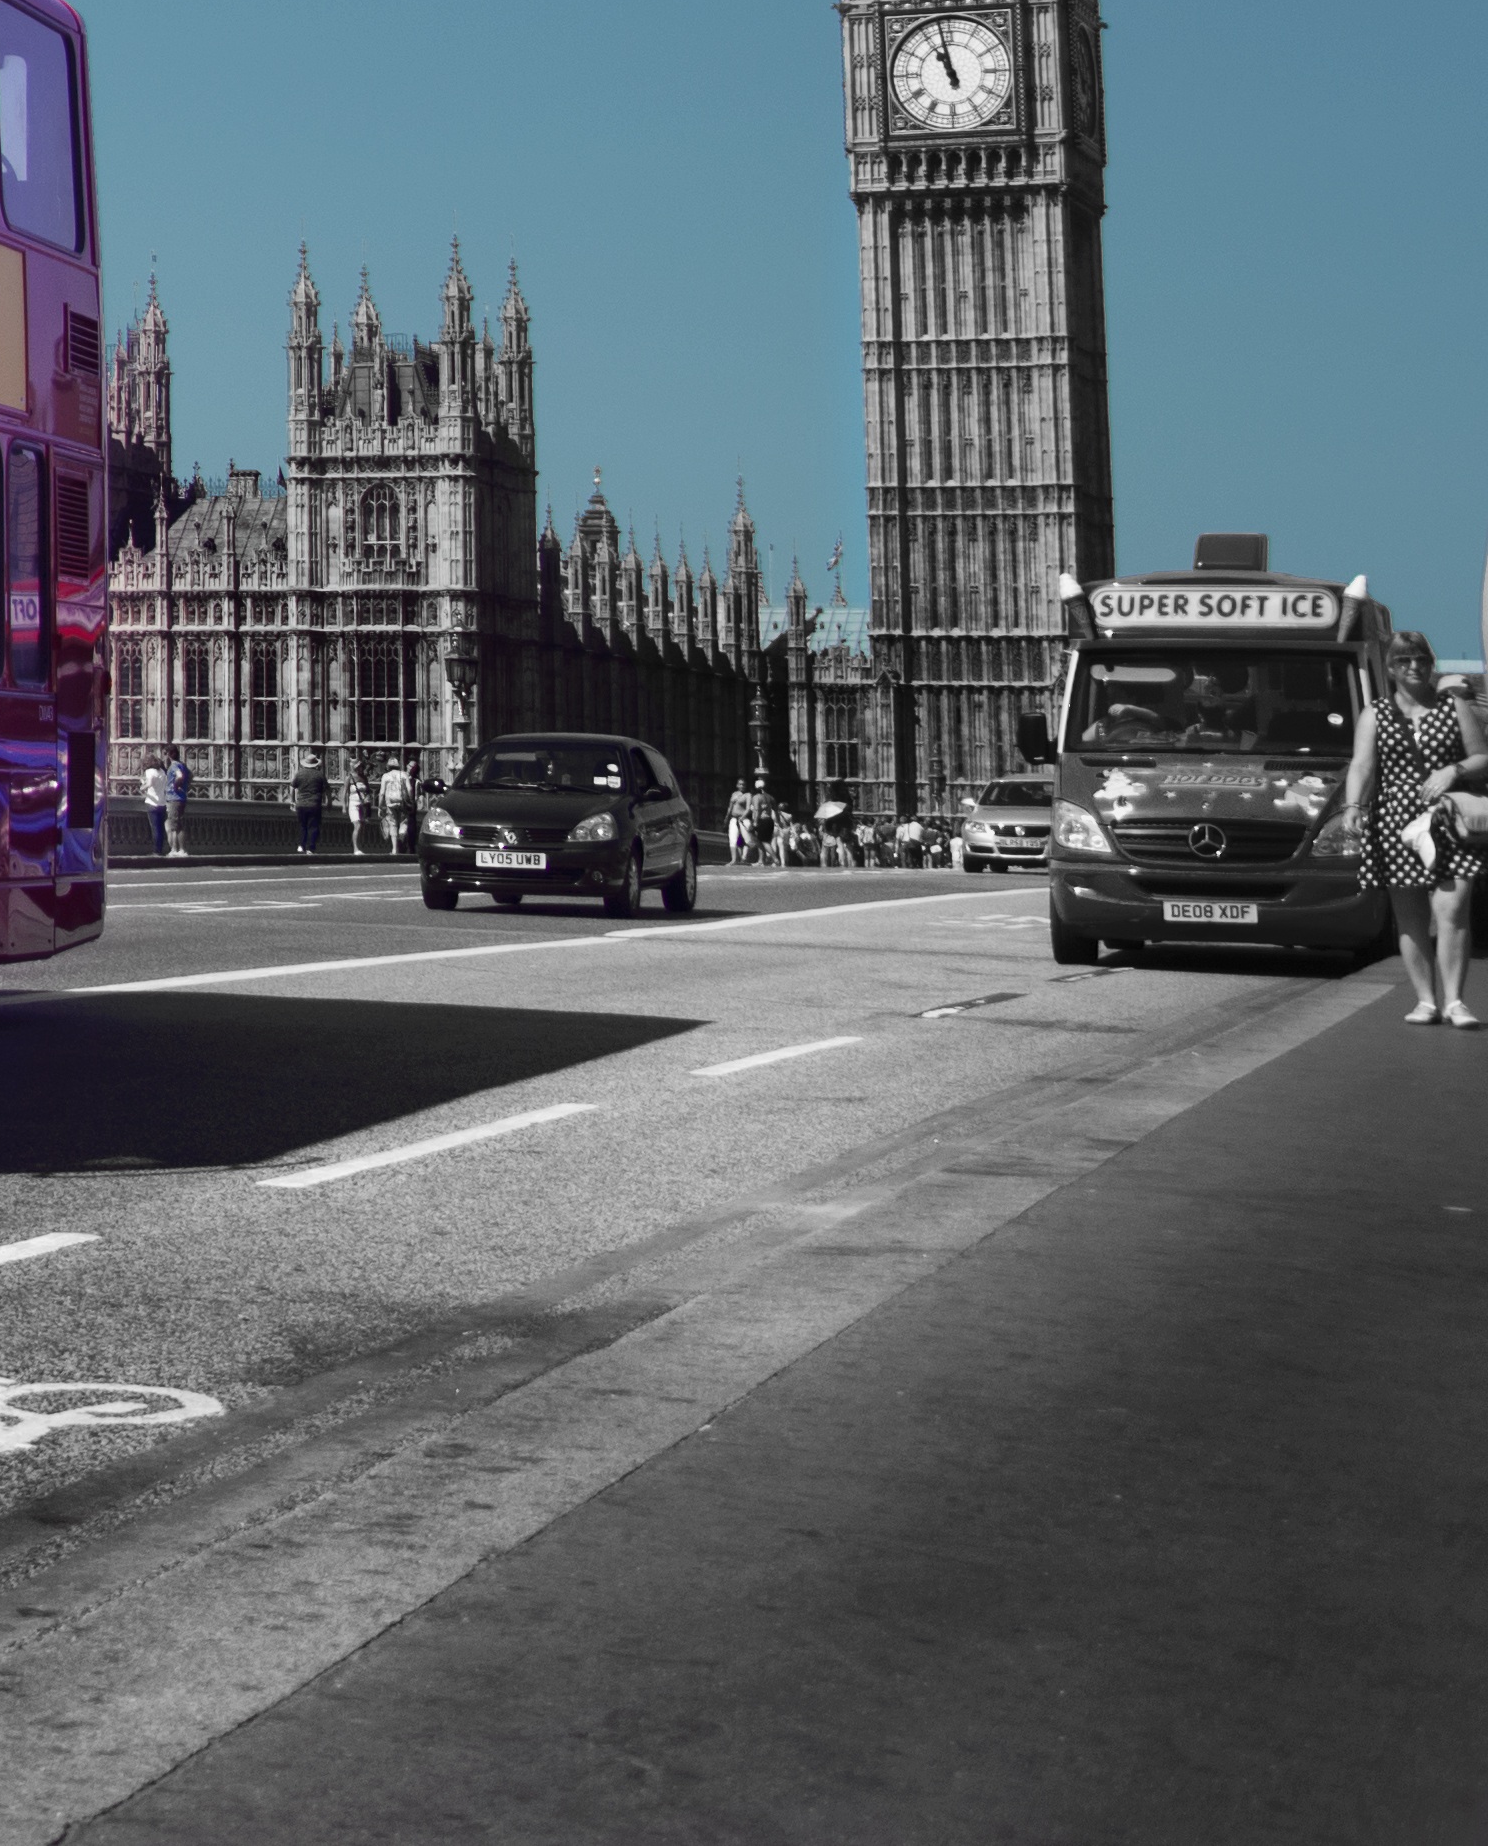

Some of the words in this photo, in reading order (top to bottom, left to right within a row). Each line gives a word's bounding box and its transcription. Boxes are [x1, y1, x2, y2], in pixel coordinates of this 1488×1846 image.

[1099, 594, 1188, 617] SUPER
[1198, 594, 1270, 617] SOFT
[1281, 594, 1325, 617] ICE
[480, 852, 512, 865] LY05
[1171, 904, 1213, 918] DE08
[1218, 905, 1250, 919] XDF
